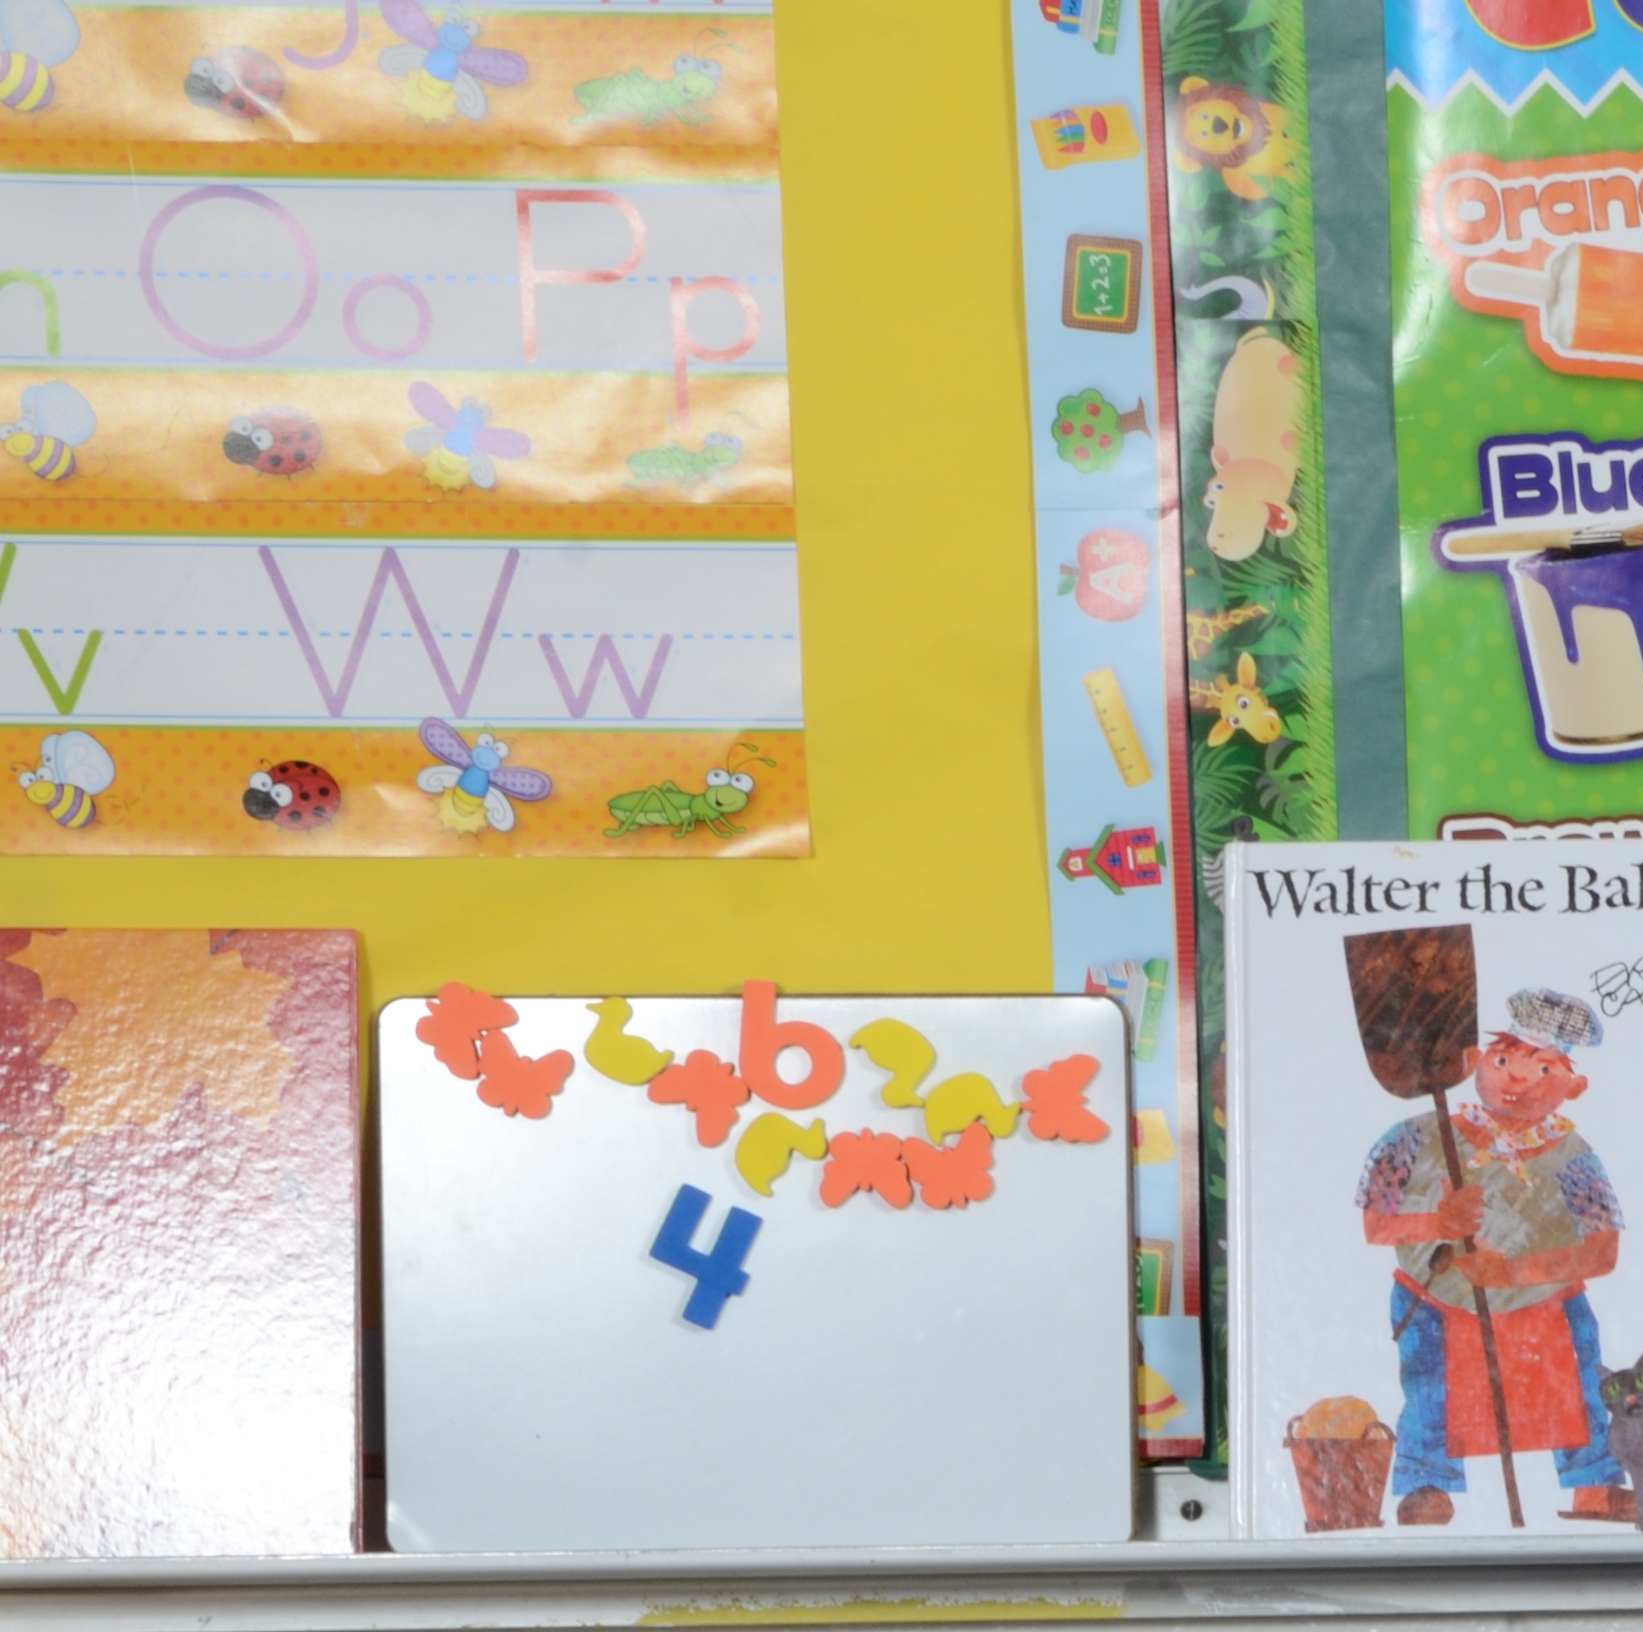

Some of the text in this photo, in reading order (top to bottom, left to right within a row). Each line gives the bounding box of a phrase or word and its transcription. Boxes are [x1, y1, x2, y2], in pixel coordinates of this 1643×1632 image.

[1247, 866, 1440, 918] Walter
[1458, 864, 1544, 912] the
[738, 980, 845, 1109] b
[650, 1184, 763, 1330] 4
